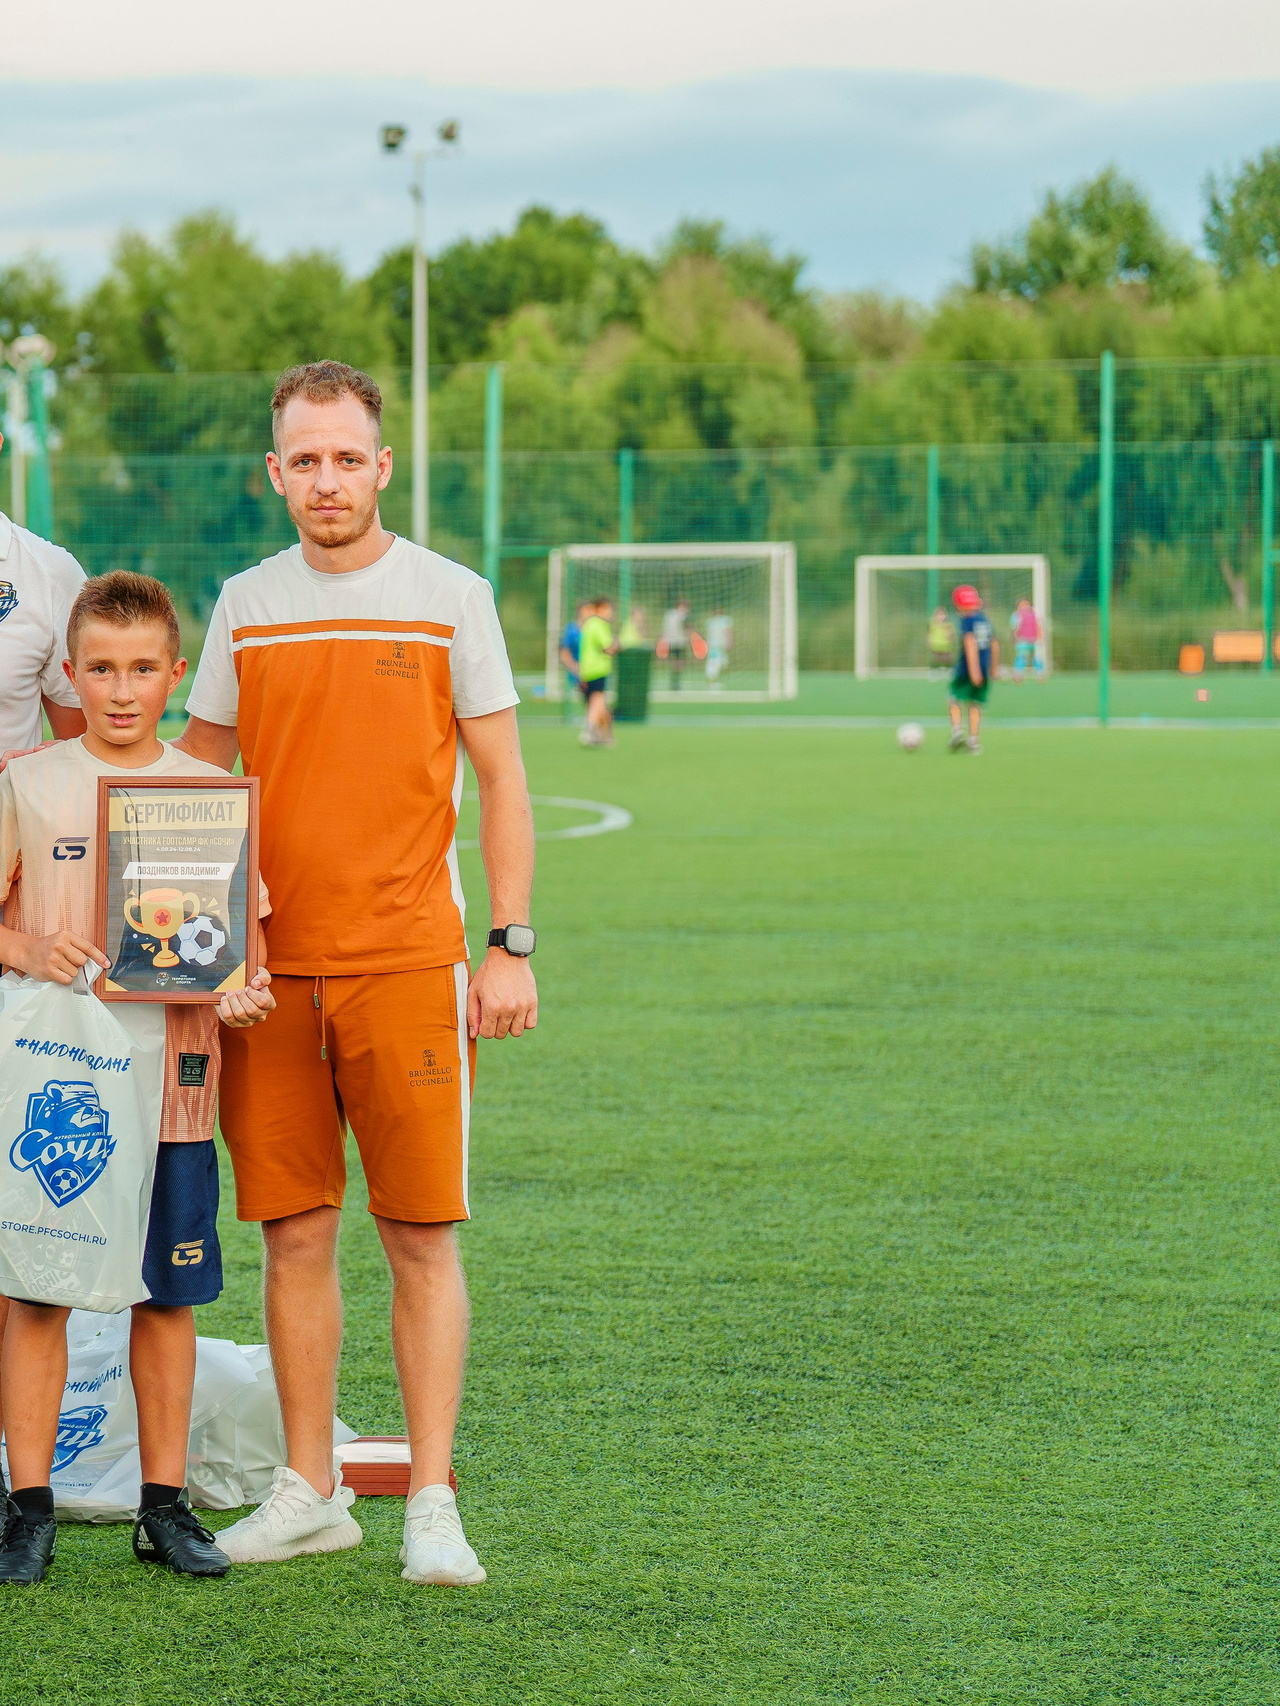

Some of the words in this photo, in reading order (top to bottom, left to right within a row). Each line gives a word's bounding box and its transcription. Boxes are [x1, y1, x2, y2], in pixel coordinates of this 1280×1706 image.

[376, 659, 420, 670] BRUNELLO
[374, 668, 419, 679] CUCINELLI
[124, 801, 236, 824] СЕРТИФИКАТ
[122, 836, 161, 845] УЧАСТНИКА
[197, 837, 209, 846] ФК
[137, 865, 179, 877] ПОЗДНЯКОВ
[180, 866, 221, 877] ВЛАДИМИР
[408, 1066, 452, 1078] BRUNELLO
[409, 1076, 453, 1087] CUCINELLI
[1, 1220, 107, 1246] STORE.PFCSOCHI.RU
